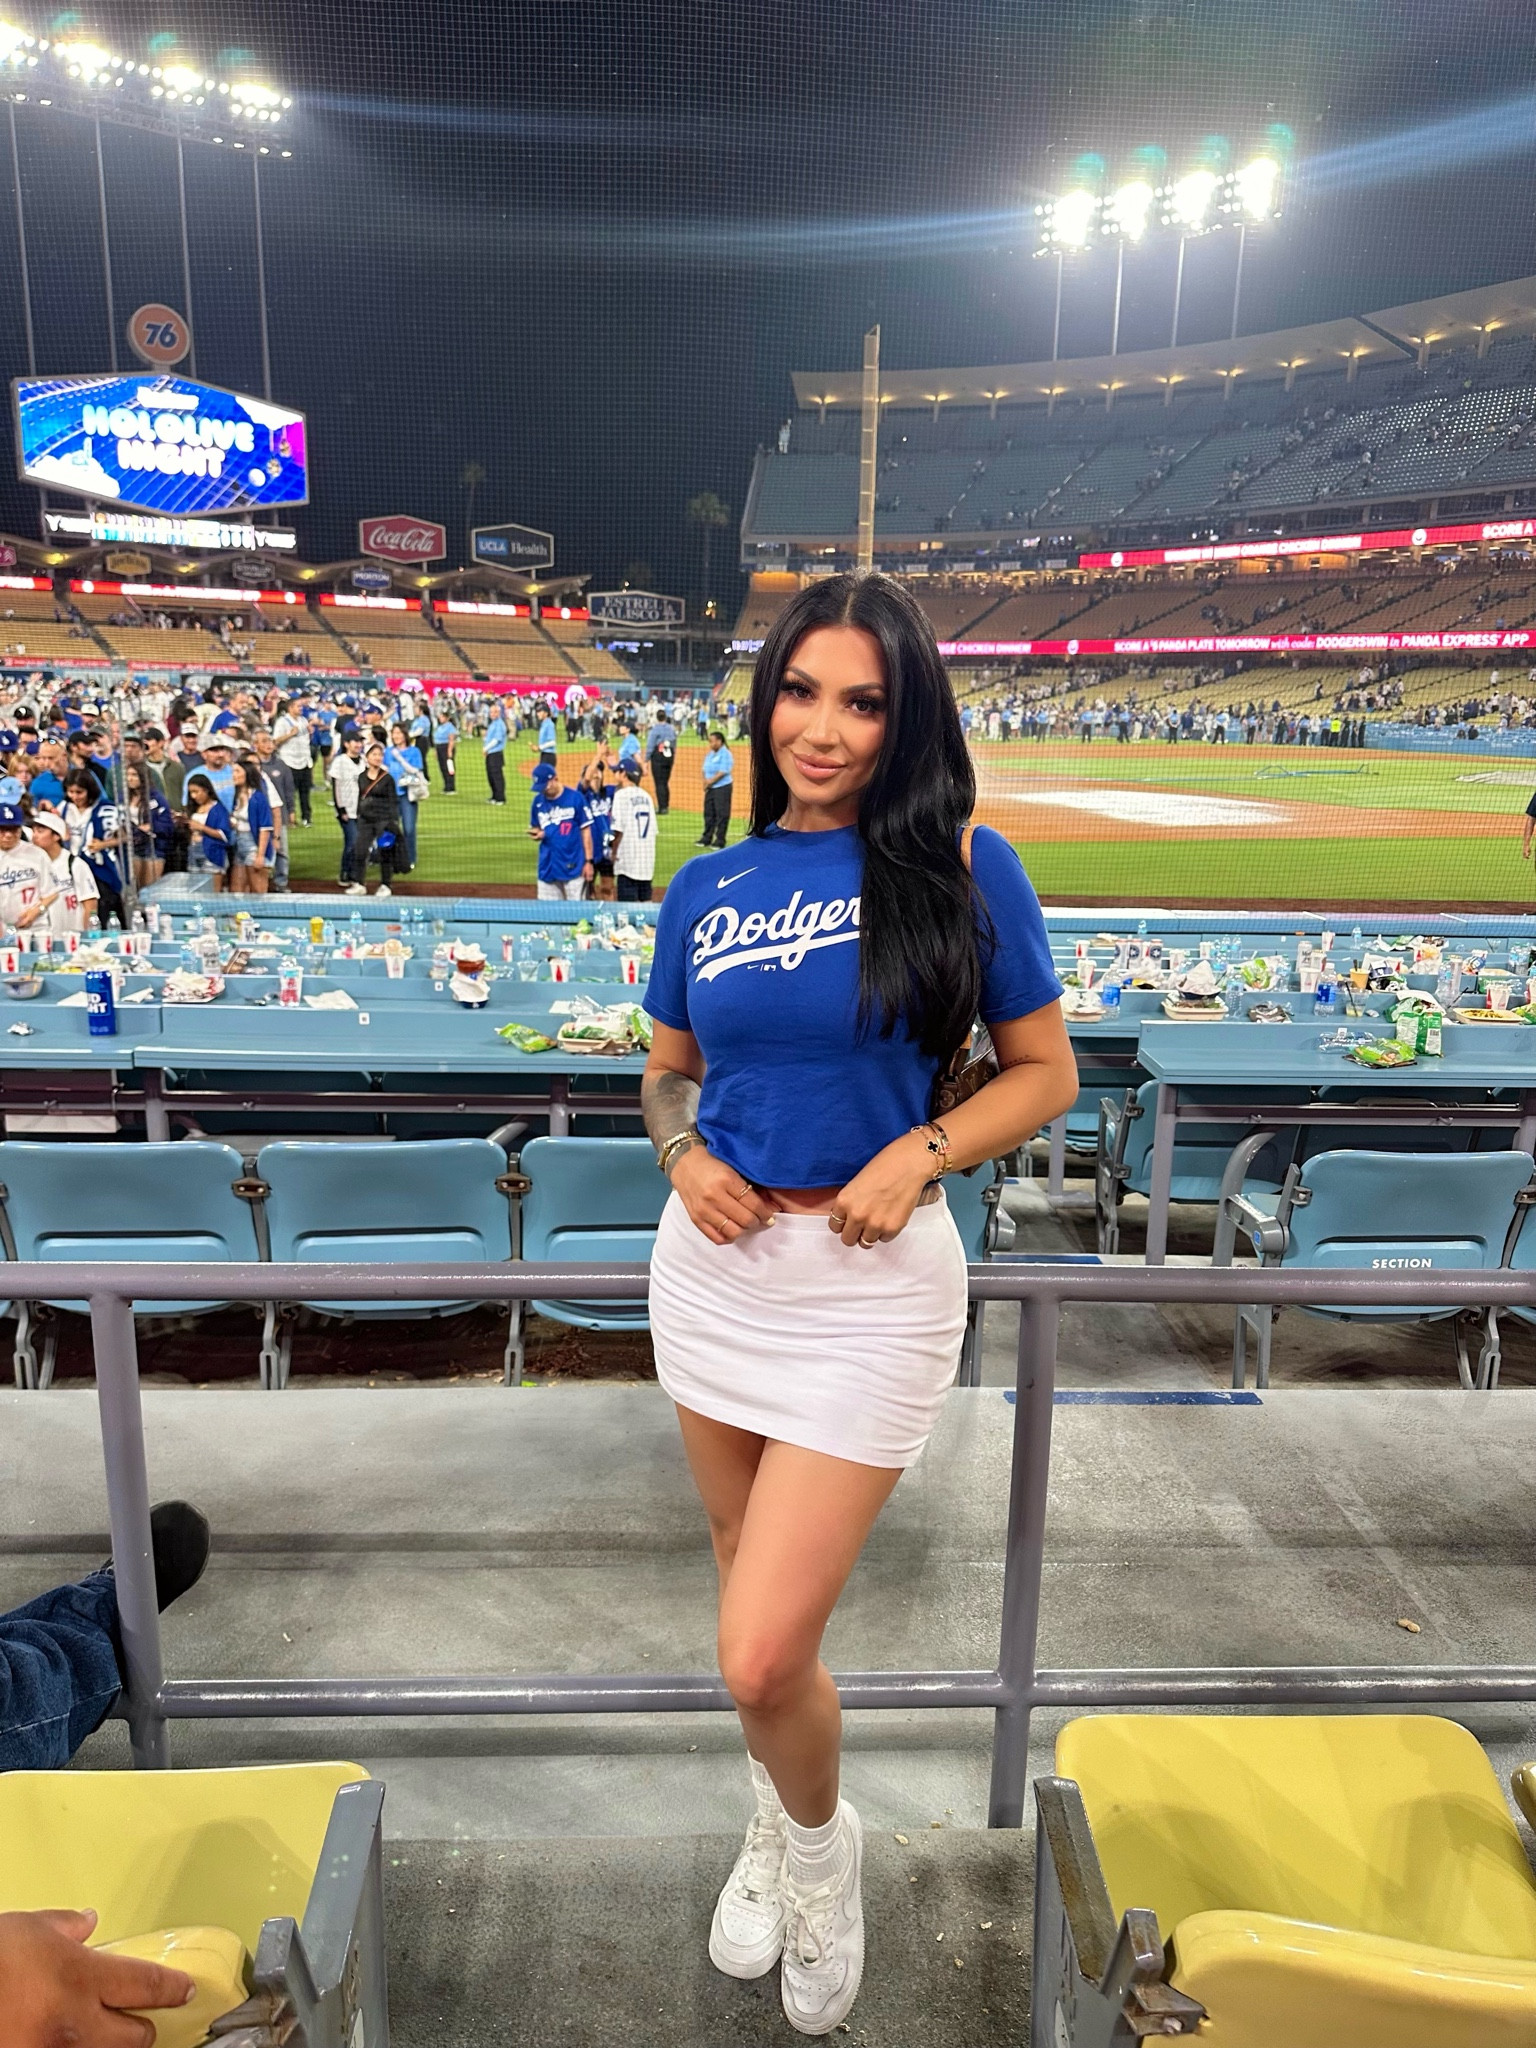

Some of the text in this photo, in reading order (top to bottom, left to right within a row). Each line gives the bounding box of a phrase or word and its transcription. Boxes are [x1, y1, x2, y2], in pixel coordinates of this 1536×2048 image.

[145, 322, 178, 348] 76
[83, 404, 254, 452] HOLOLIVE
[117, 439, 225, 478] NIGHT
[1482, 522, 1534, 538] SCORE A
[479, 540, 548, 556] UCLA Health
[598, 606, 660, 620] JALISCO
[1188, 639, 1213, 651] PLATE
[1215, 638, 1270, 650] TOMORROW
[1271, 636, 1289, 649] with
[1316, 636, 1388, 648] DODGERSWIN
[1401, 635, 1440, 647] PANDA
[1502, 633, 1529, 646] APP
[22, 887, 36, 905] 17
[1372, 1258, 1432, 1269] SECTION
